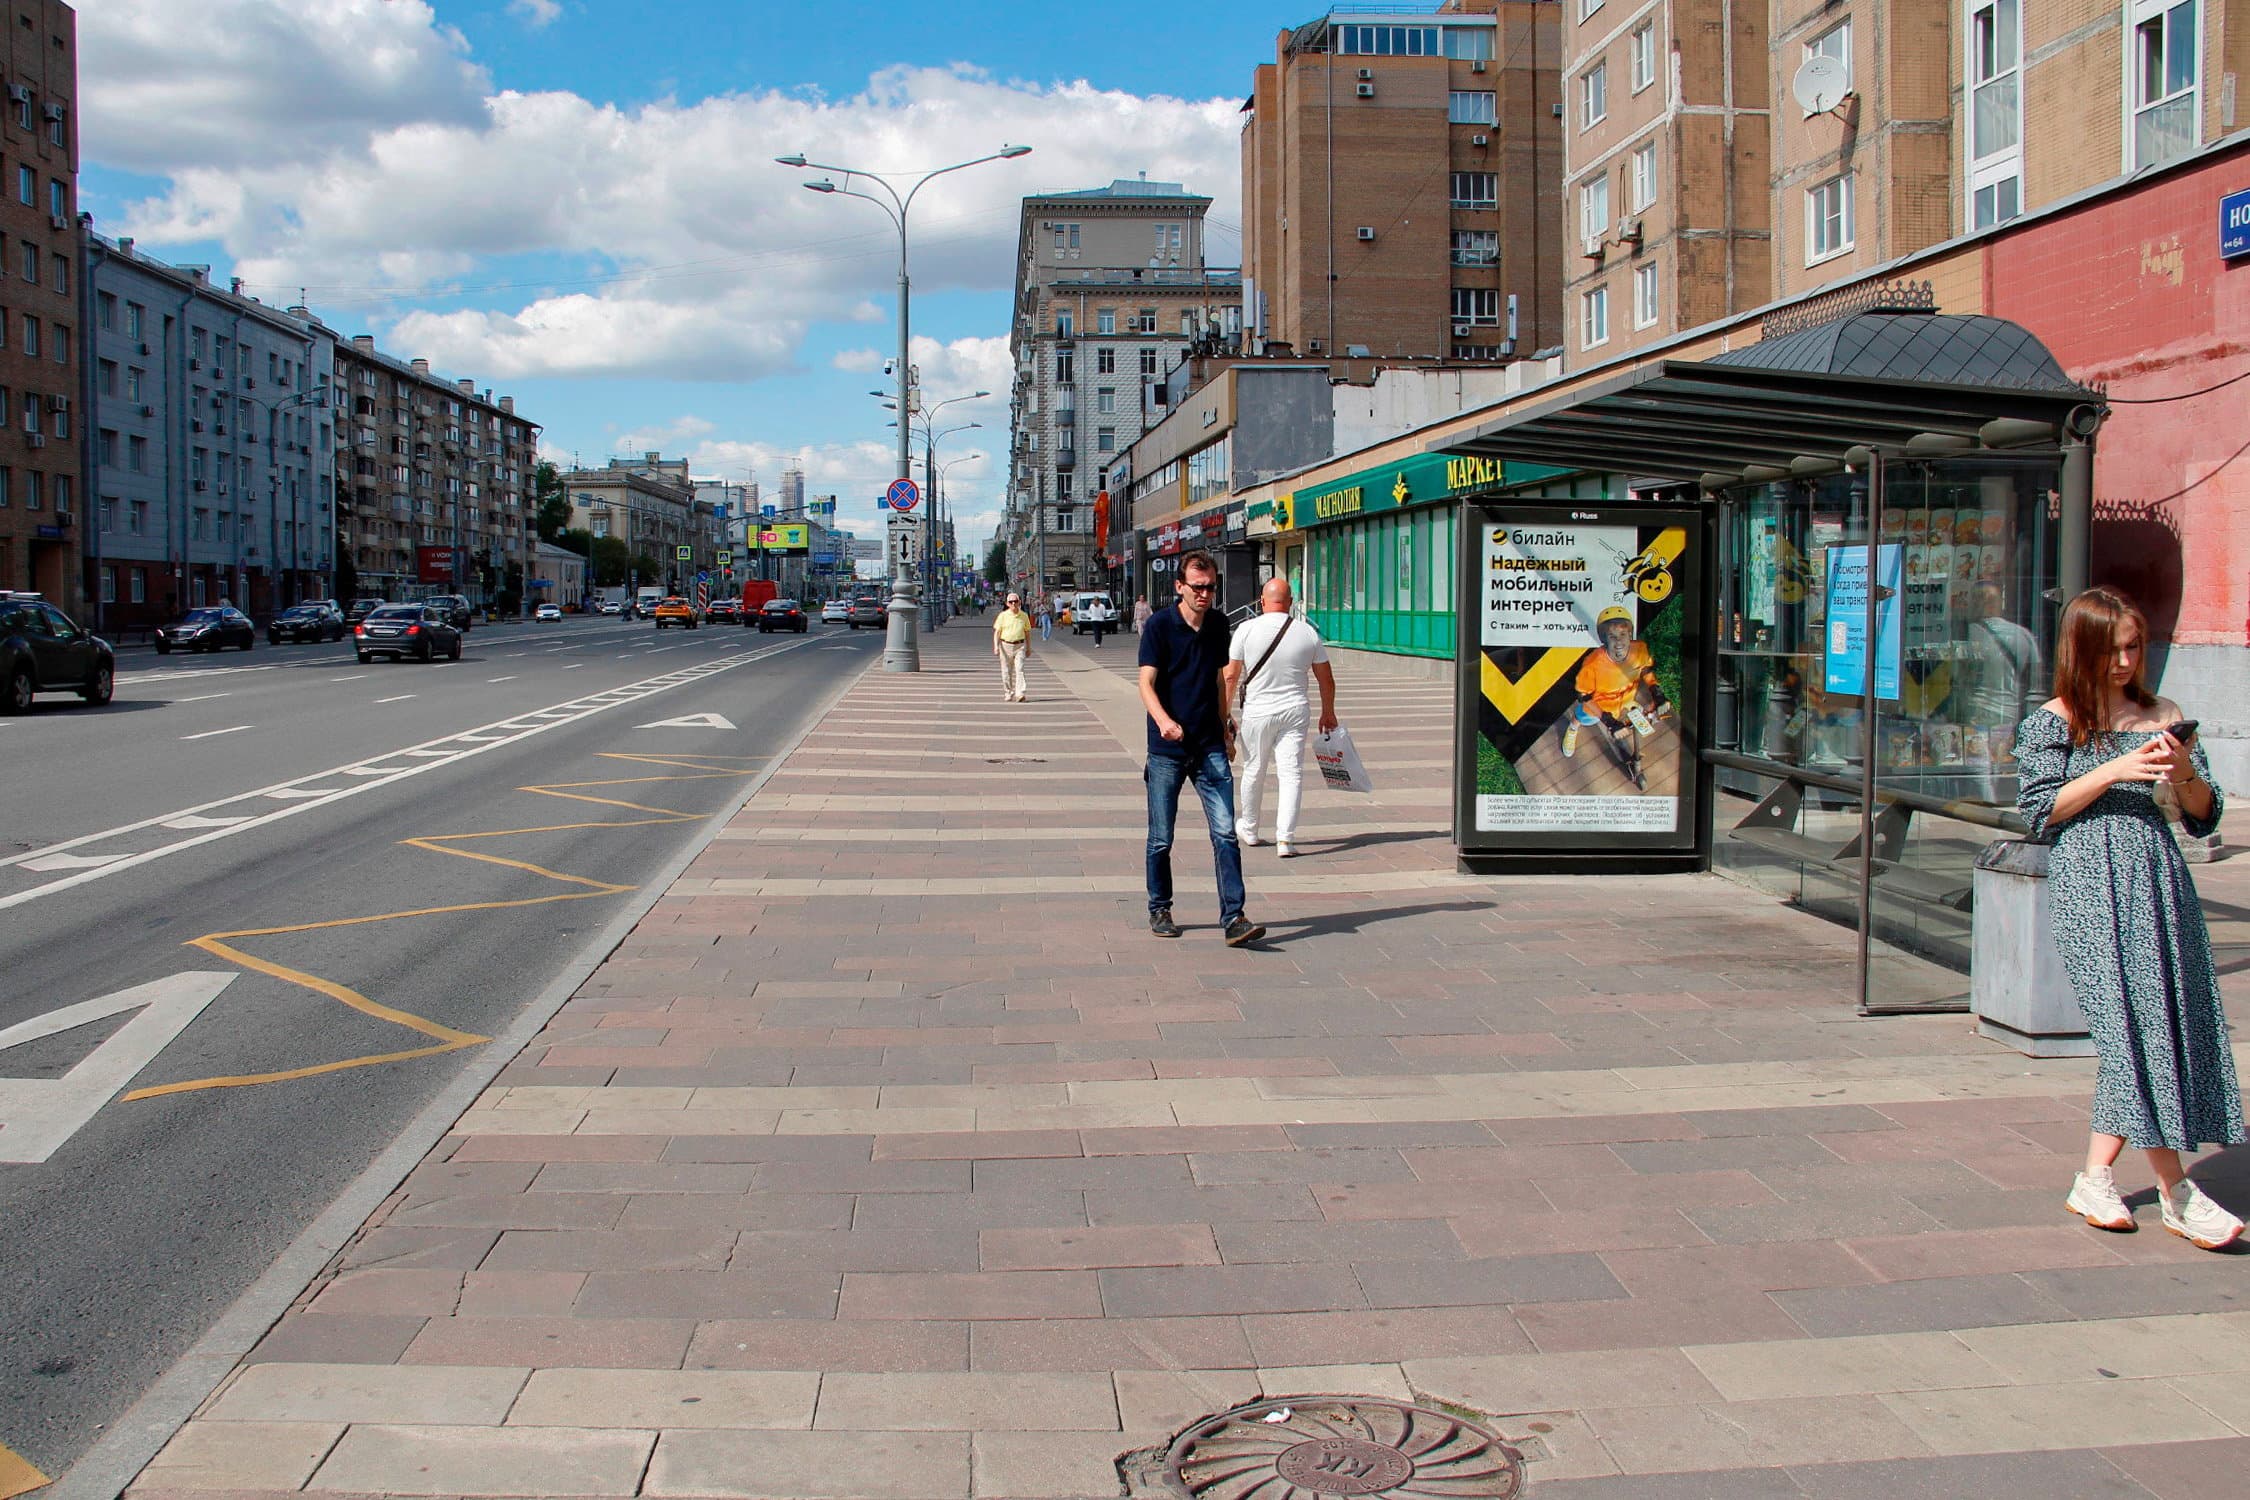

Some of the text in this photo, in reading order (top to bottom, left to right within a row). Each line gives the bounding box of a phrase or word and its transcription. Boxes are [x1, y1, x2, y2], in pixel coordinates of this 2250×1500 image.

[2233, 236, 2243, 248] 64
[1315, 486, 1362, 519] МАГНОЛИЯ
[1512, 529, 1575, 546] билайн
[1491, 554, 1585, 572] Надёжный
[1491, 575, 1593, 592] мобильный
[1491, 599, 1575, 615] интернет
[1833, 596, 1846, 605] ваш
[1490, 621, 1498, 630] С
[1500, 622, 1529, 631] таким
[1543, 623, 1565, 631] хоть
[1566, 624, 1590, 633] куда
